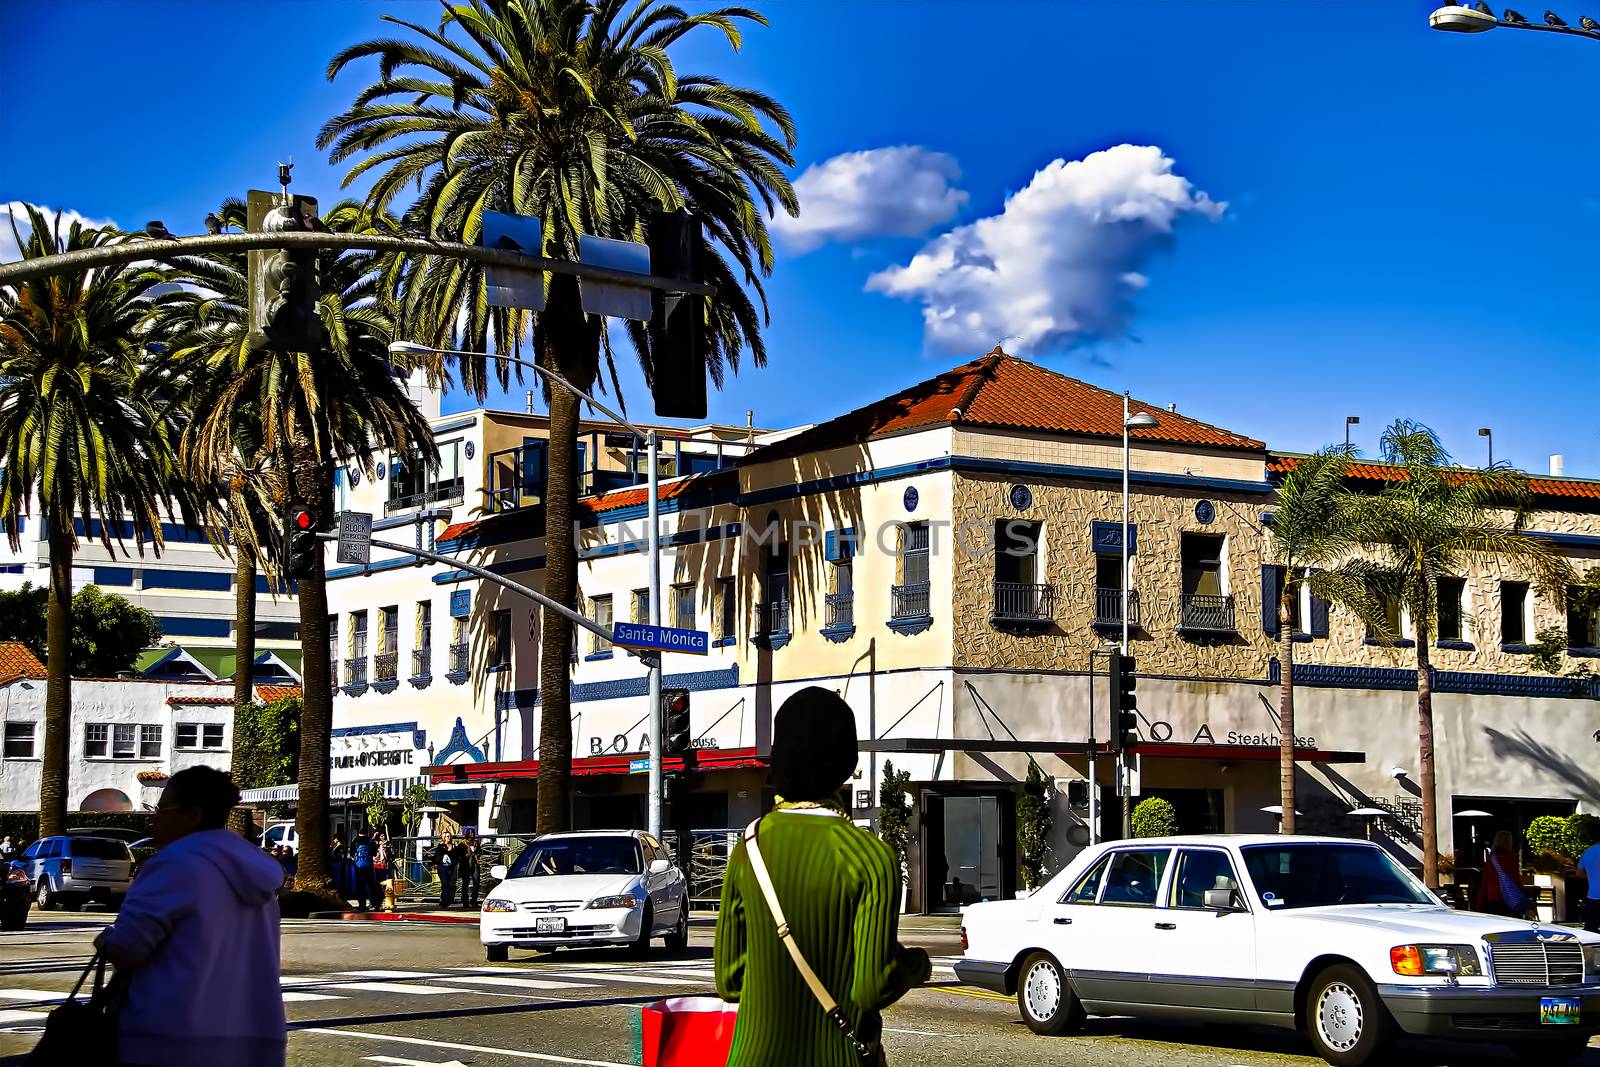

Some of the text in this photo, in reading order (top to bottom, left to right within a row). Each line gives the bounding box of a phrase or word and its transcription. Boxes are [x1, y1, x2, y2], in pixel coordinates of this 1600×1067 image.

[345, 523, 366, 533] BLOCK
[343, 543, 358, 551] FINES
[618, 625, 705, 647] Santa Monica
[590, 732, 652, 756] BOA
[1149, 721, 1316, 747] OA Steakhuse
